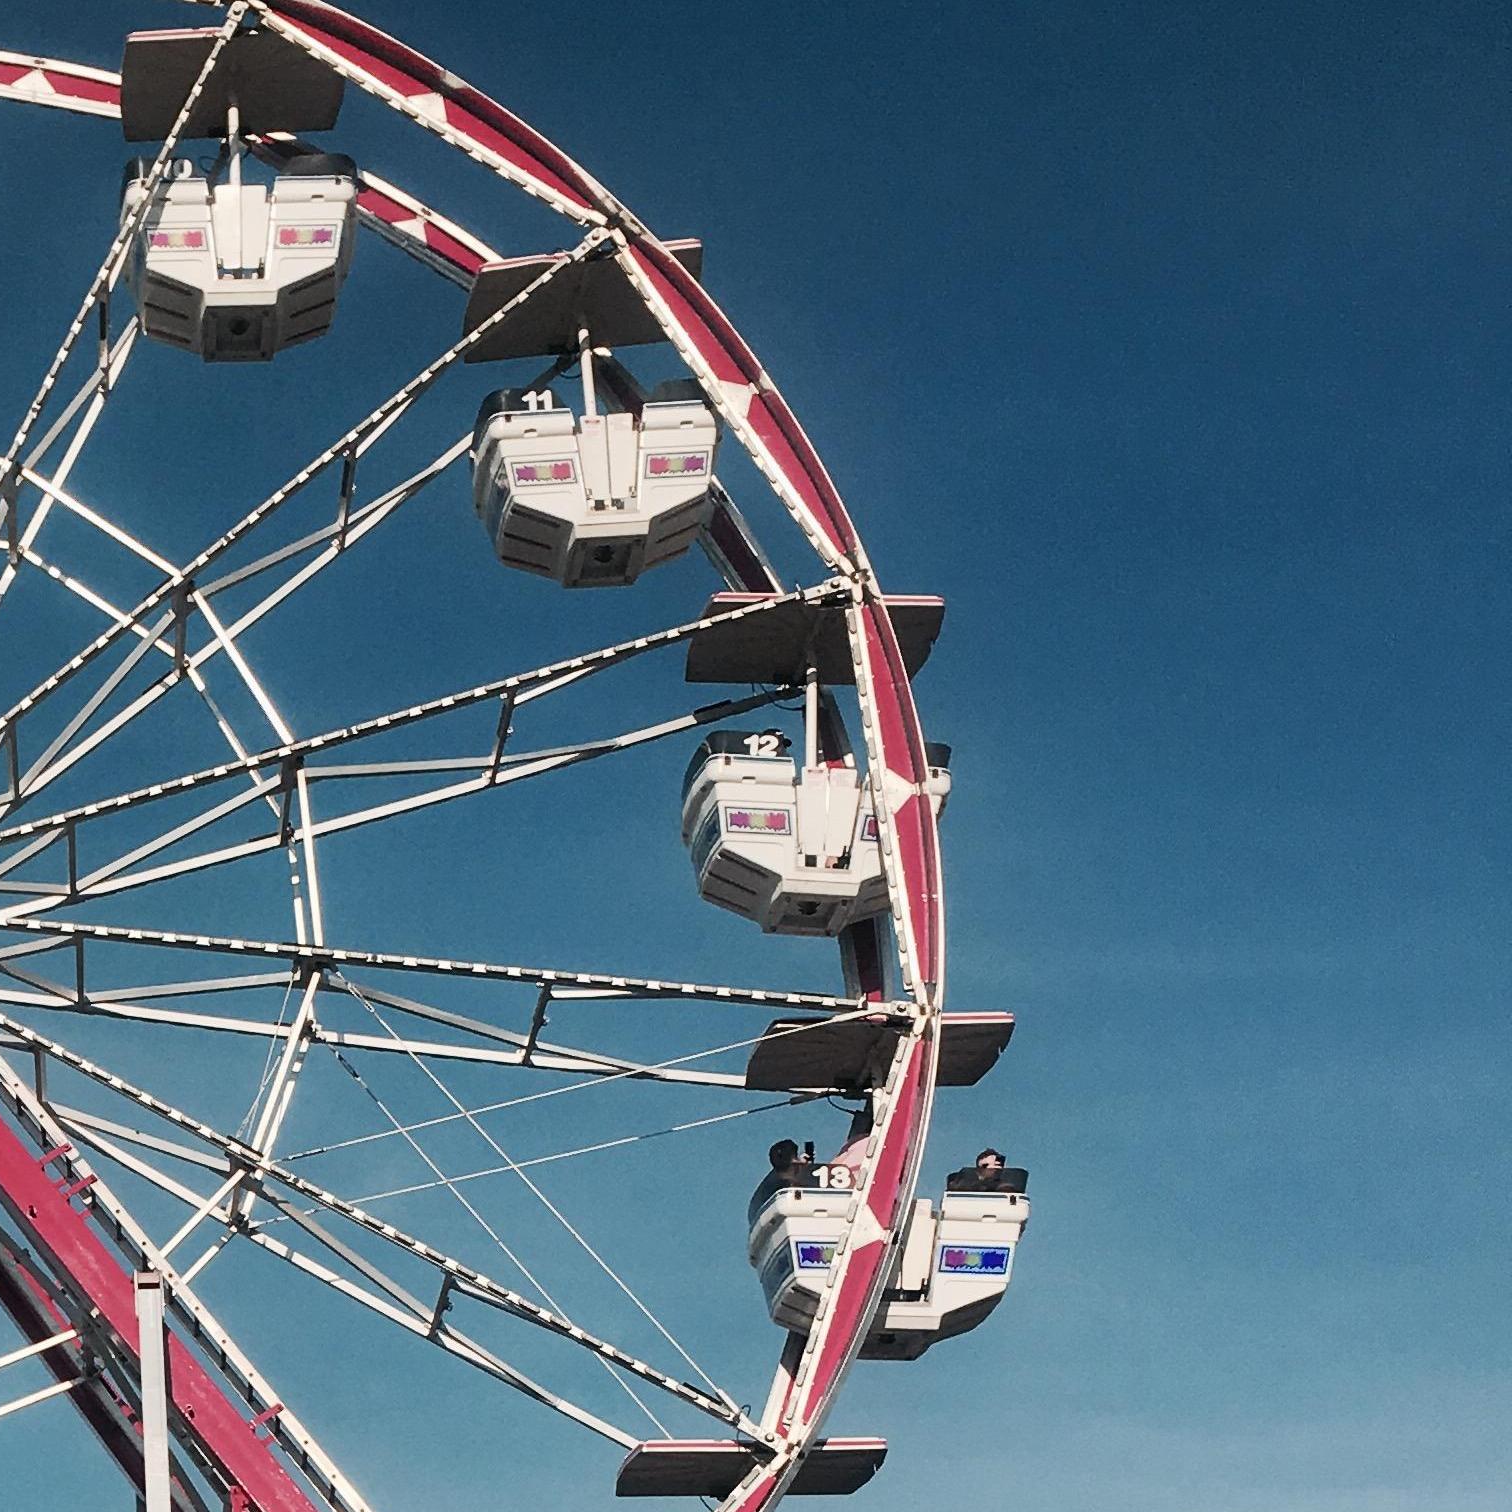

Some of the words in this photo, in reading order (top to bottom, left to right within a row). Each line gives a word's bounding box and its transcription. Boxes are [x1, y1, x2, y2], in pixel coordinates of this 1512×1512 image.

[521, 389, 553, 411] 11
[743, 733, 780, 756] 12
[811, 1165, 853, 1189] 13
